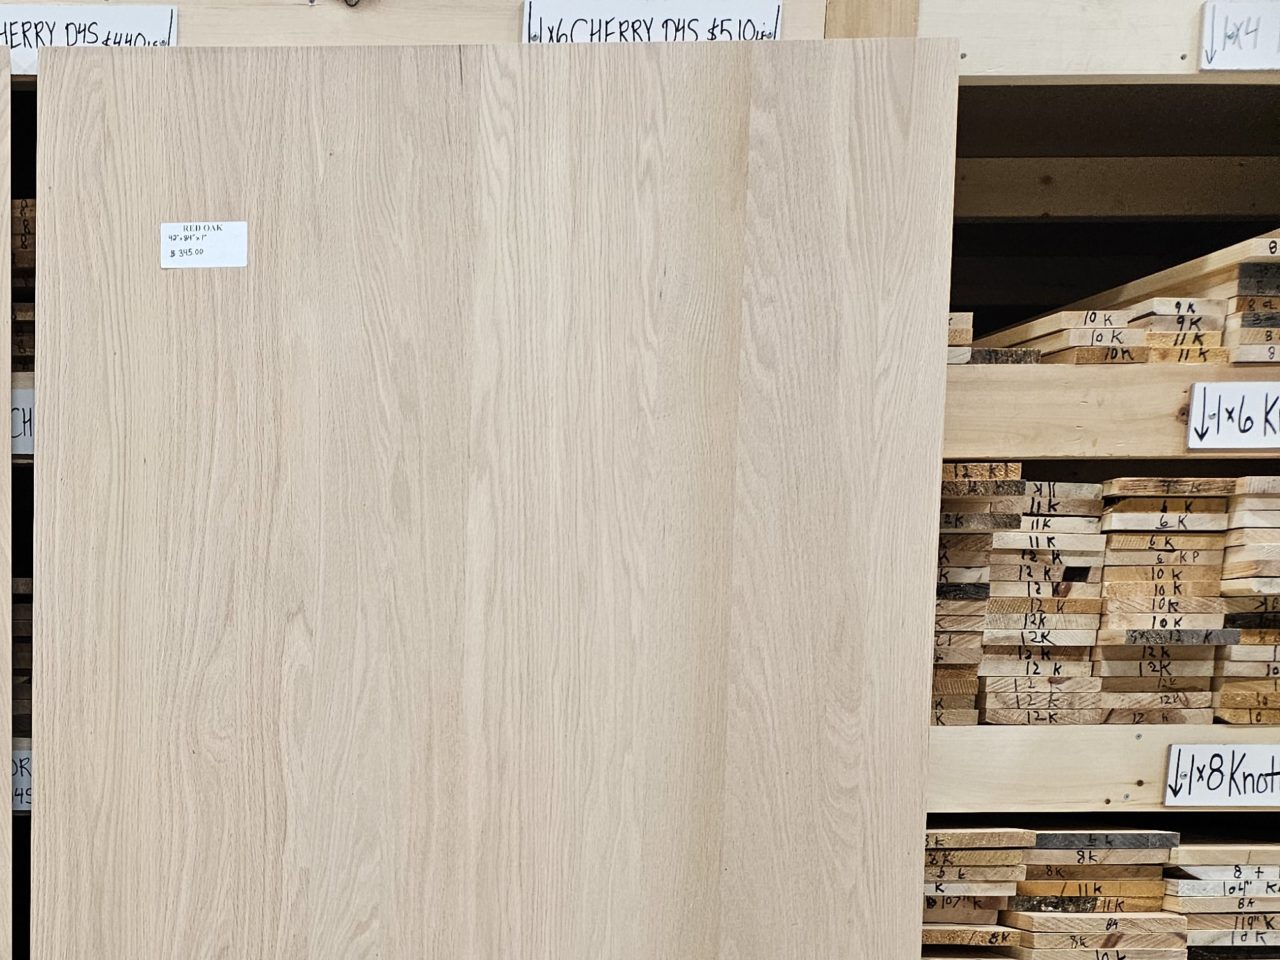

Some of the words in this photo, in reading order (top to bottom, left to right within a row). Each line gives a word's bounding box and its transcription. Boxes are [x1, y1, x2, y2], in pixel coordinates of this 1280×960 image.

[183, 224, 201, 232] RED
[203, 224, 223, 232] OAK
[1217, 394, 1254, 434] 1x6
[1188, 752, 1225, 796] 1x8
[1228, 749, 1280, 797] Knot
